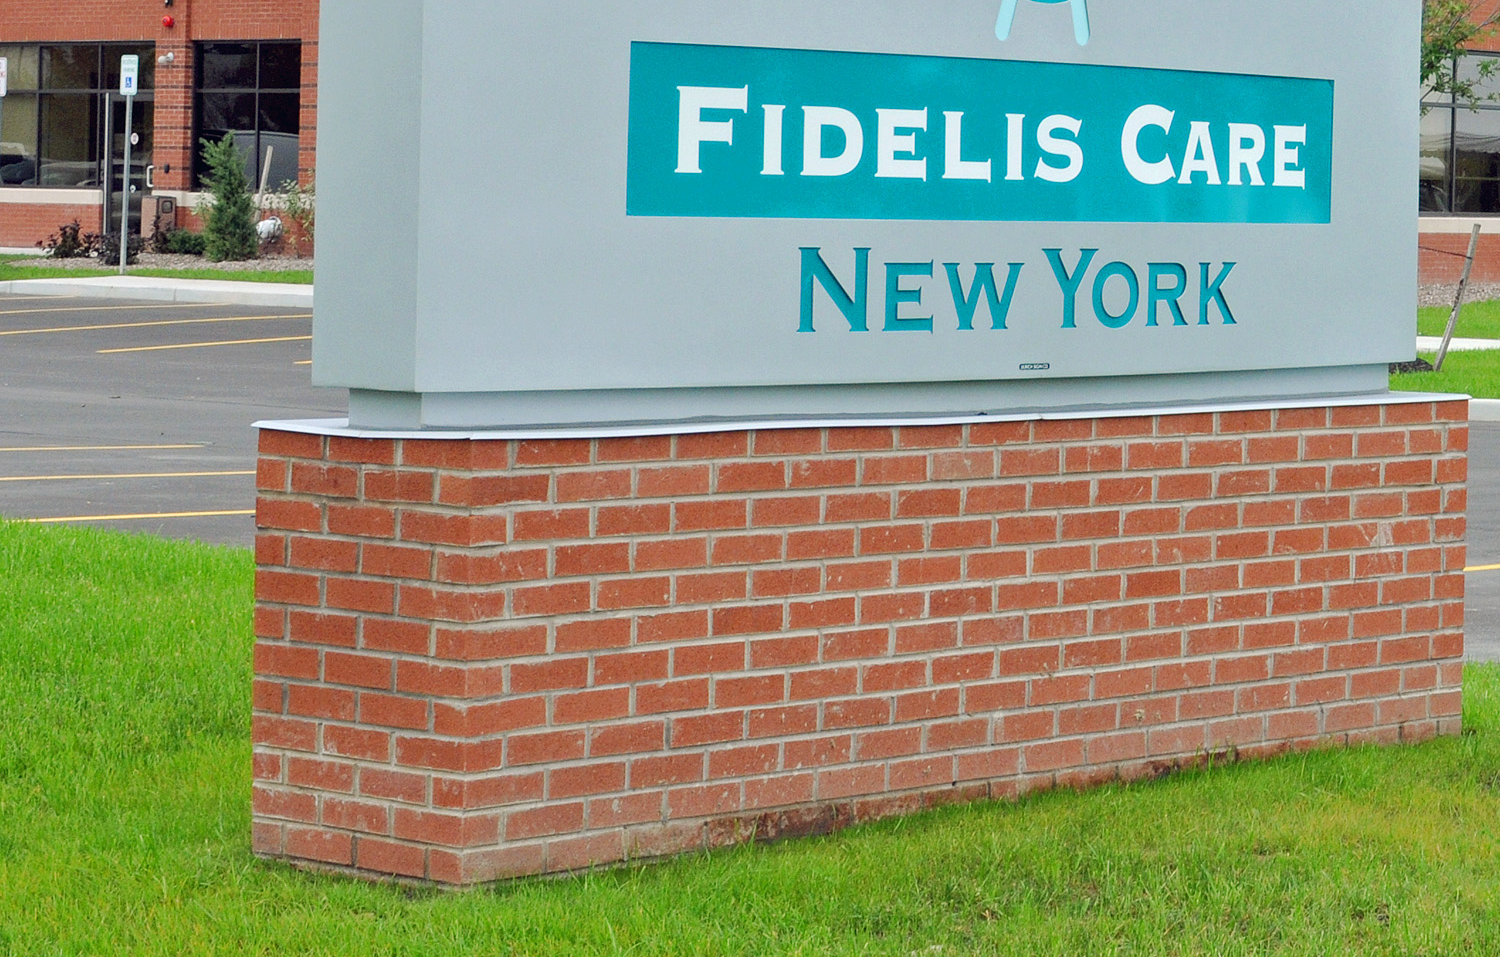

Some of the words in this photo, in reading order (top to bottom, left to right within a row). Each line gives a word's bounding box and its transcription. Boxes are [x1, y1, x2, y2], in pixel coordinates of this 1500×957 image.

[674, 84, 1084, 184] FIDELIS
[1120, 104, 1306, 190] CARE
[797, 247, 1025, 334] NEW
[1041, 248, 1238, 329] YORK
